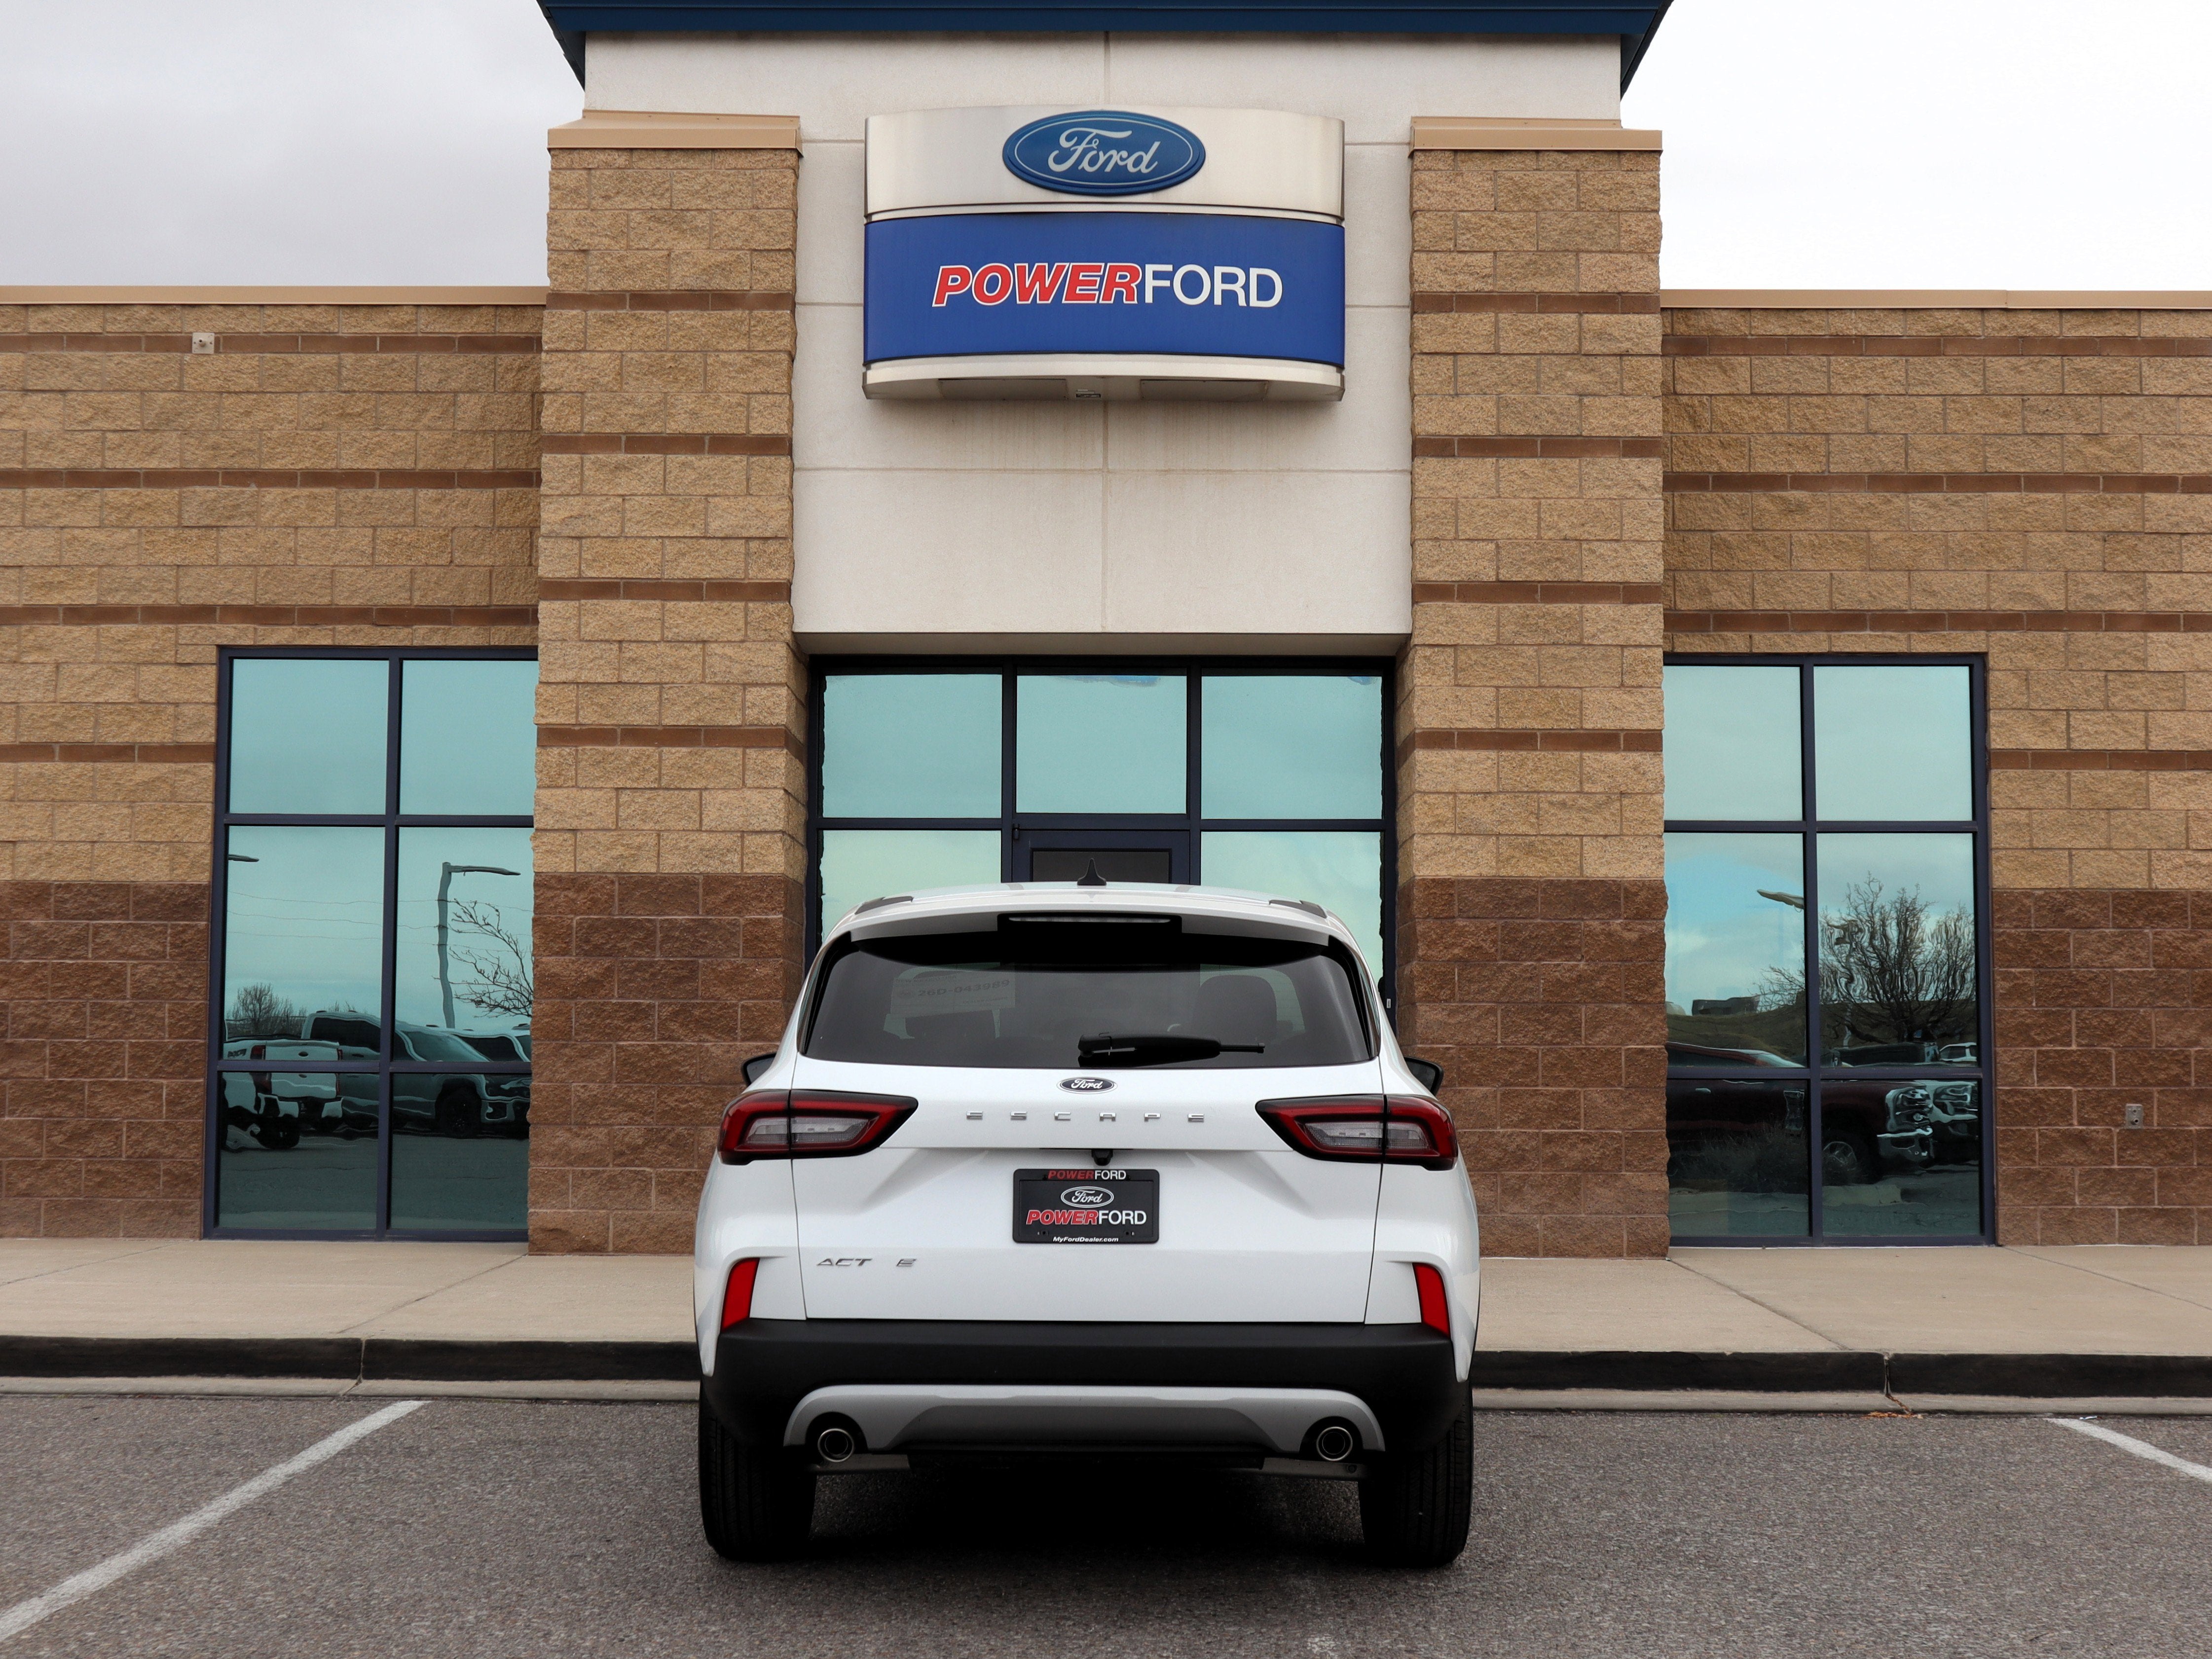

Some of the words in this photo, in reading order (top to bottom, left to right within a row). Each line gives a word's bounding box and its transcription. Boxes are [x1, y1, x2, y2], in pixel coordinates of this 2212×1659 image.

[1047, 127, 1158, 174] Ford
[931, 262, 1283, 308] POWERFORD
[1071, 1079, 1103, 1090] Ford
[966, 1110, 1205, 1122] ESCAPE
[1047, 1170, 1127, 1180] POWERFORD
[1071, 1190, 1103, 1203] Ford
[1026, 1210, 1147, 1225] POWERFORD
[816, 1258, 917, 1267] ACTE
